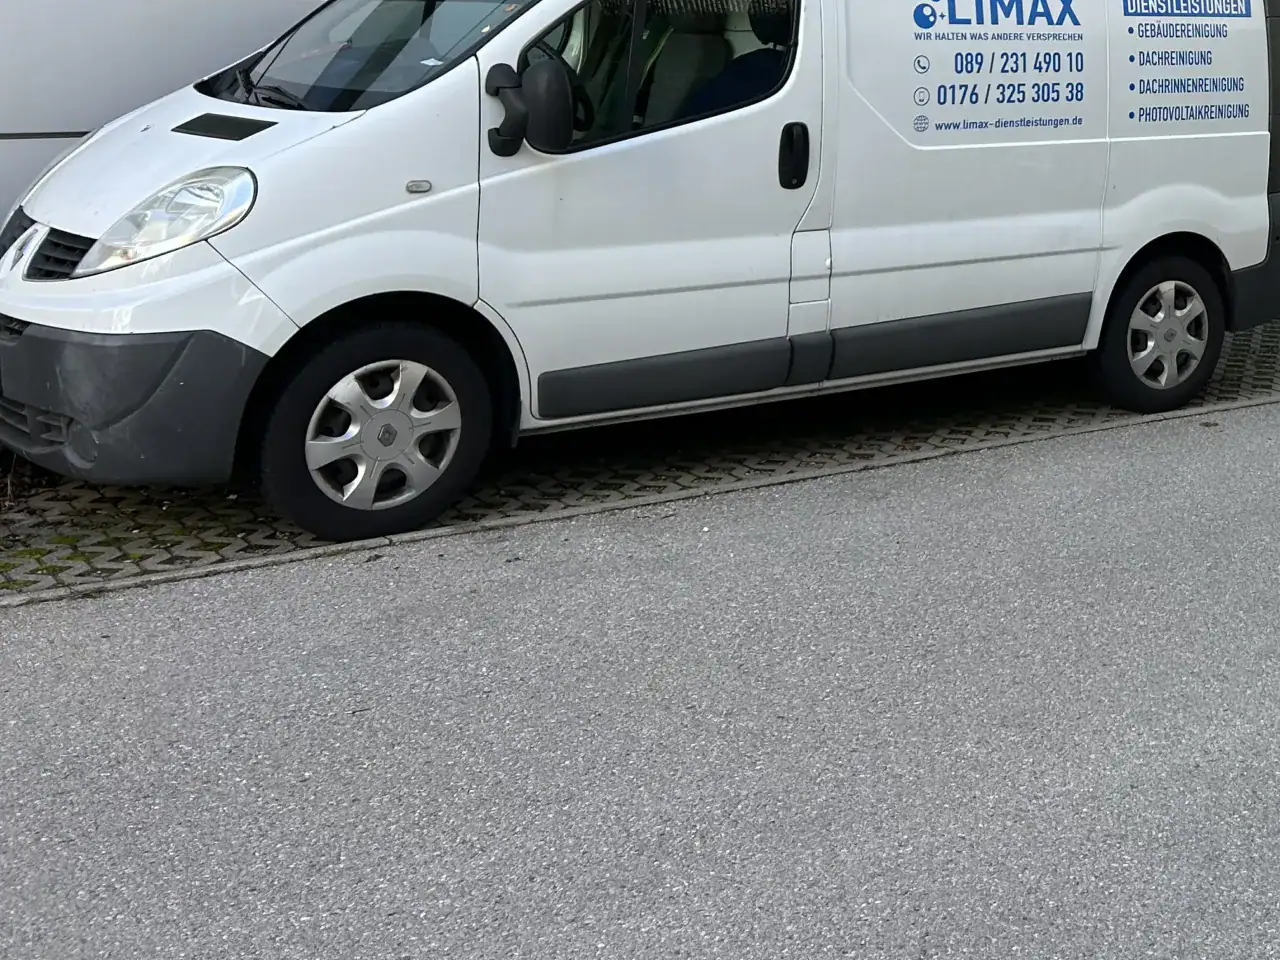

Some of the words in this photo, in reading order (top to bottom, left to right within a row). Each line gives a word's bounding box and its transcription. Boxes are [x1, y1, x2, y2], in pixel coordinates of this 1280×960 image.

[914, 32, 932, 41] WIR
[935, 32, 967, 41] HALTEN
[969, 32, 989, 41] WAS
[991, 32, 1024, 41] ANDERE
[1026, 33, 1083, 41] VERSPRECHEN
[1137, 20, 1228, 39] GEBÄUDEREINIGUNG
[954, 52, 984, 74] 089
[989, 52, 995, 74] /
[1000, 52, 1027, 74] 231
[1034, 52, 1061, 73] 490
[1067, 52, 1084, 72] 10
[1138, 50, 1212, 67] DACHREINIGUNG
[937, 84, 979, 105] 0176
[984, 84, 991, 105] /
[996, 83, 1026, 103] 325
[1031, 82, 1060, 102] 305
[1065, 82, 1084, 102] 38
[1139, 77, 1245, 95] DACHRINNENREINIGUNG
[1138, 103, 1250, 122] PHOTOVOLTAIKREINIGUNG
[935, 115, 1083, 131] www.limax-dienstleistungen.de
